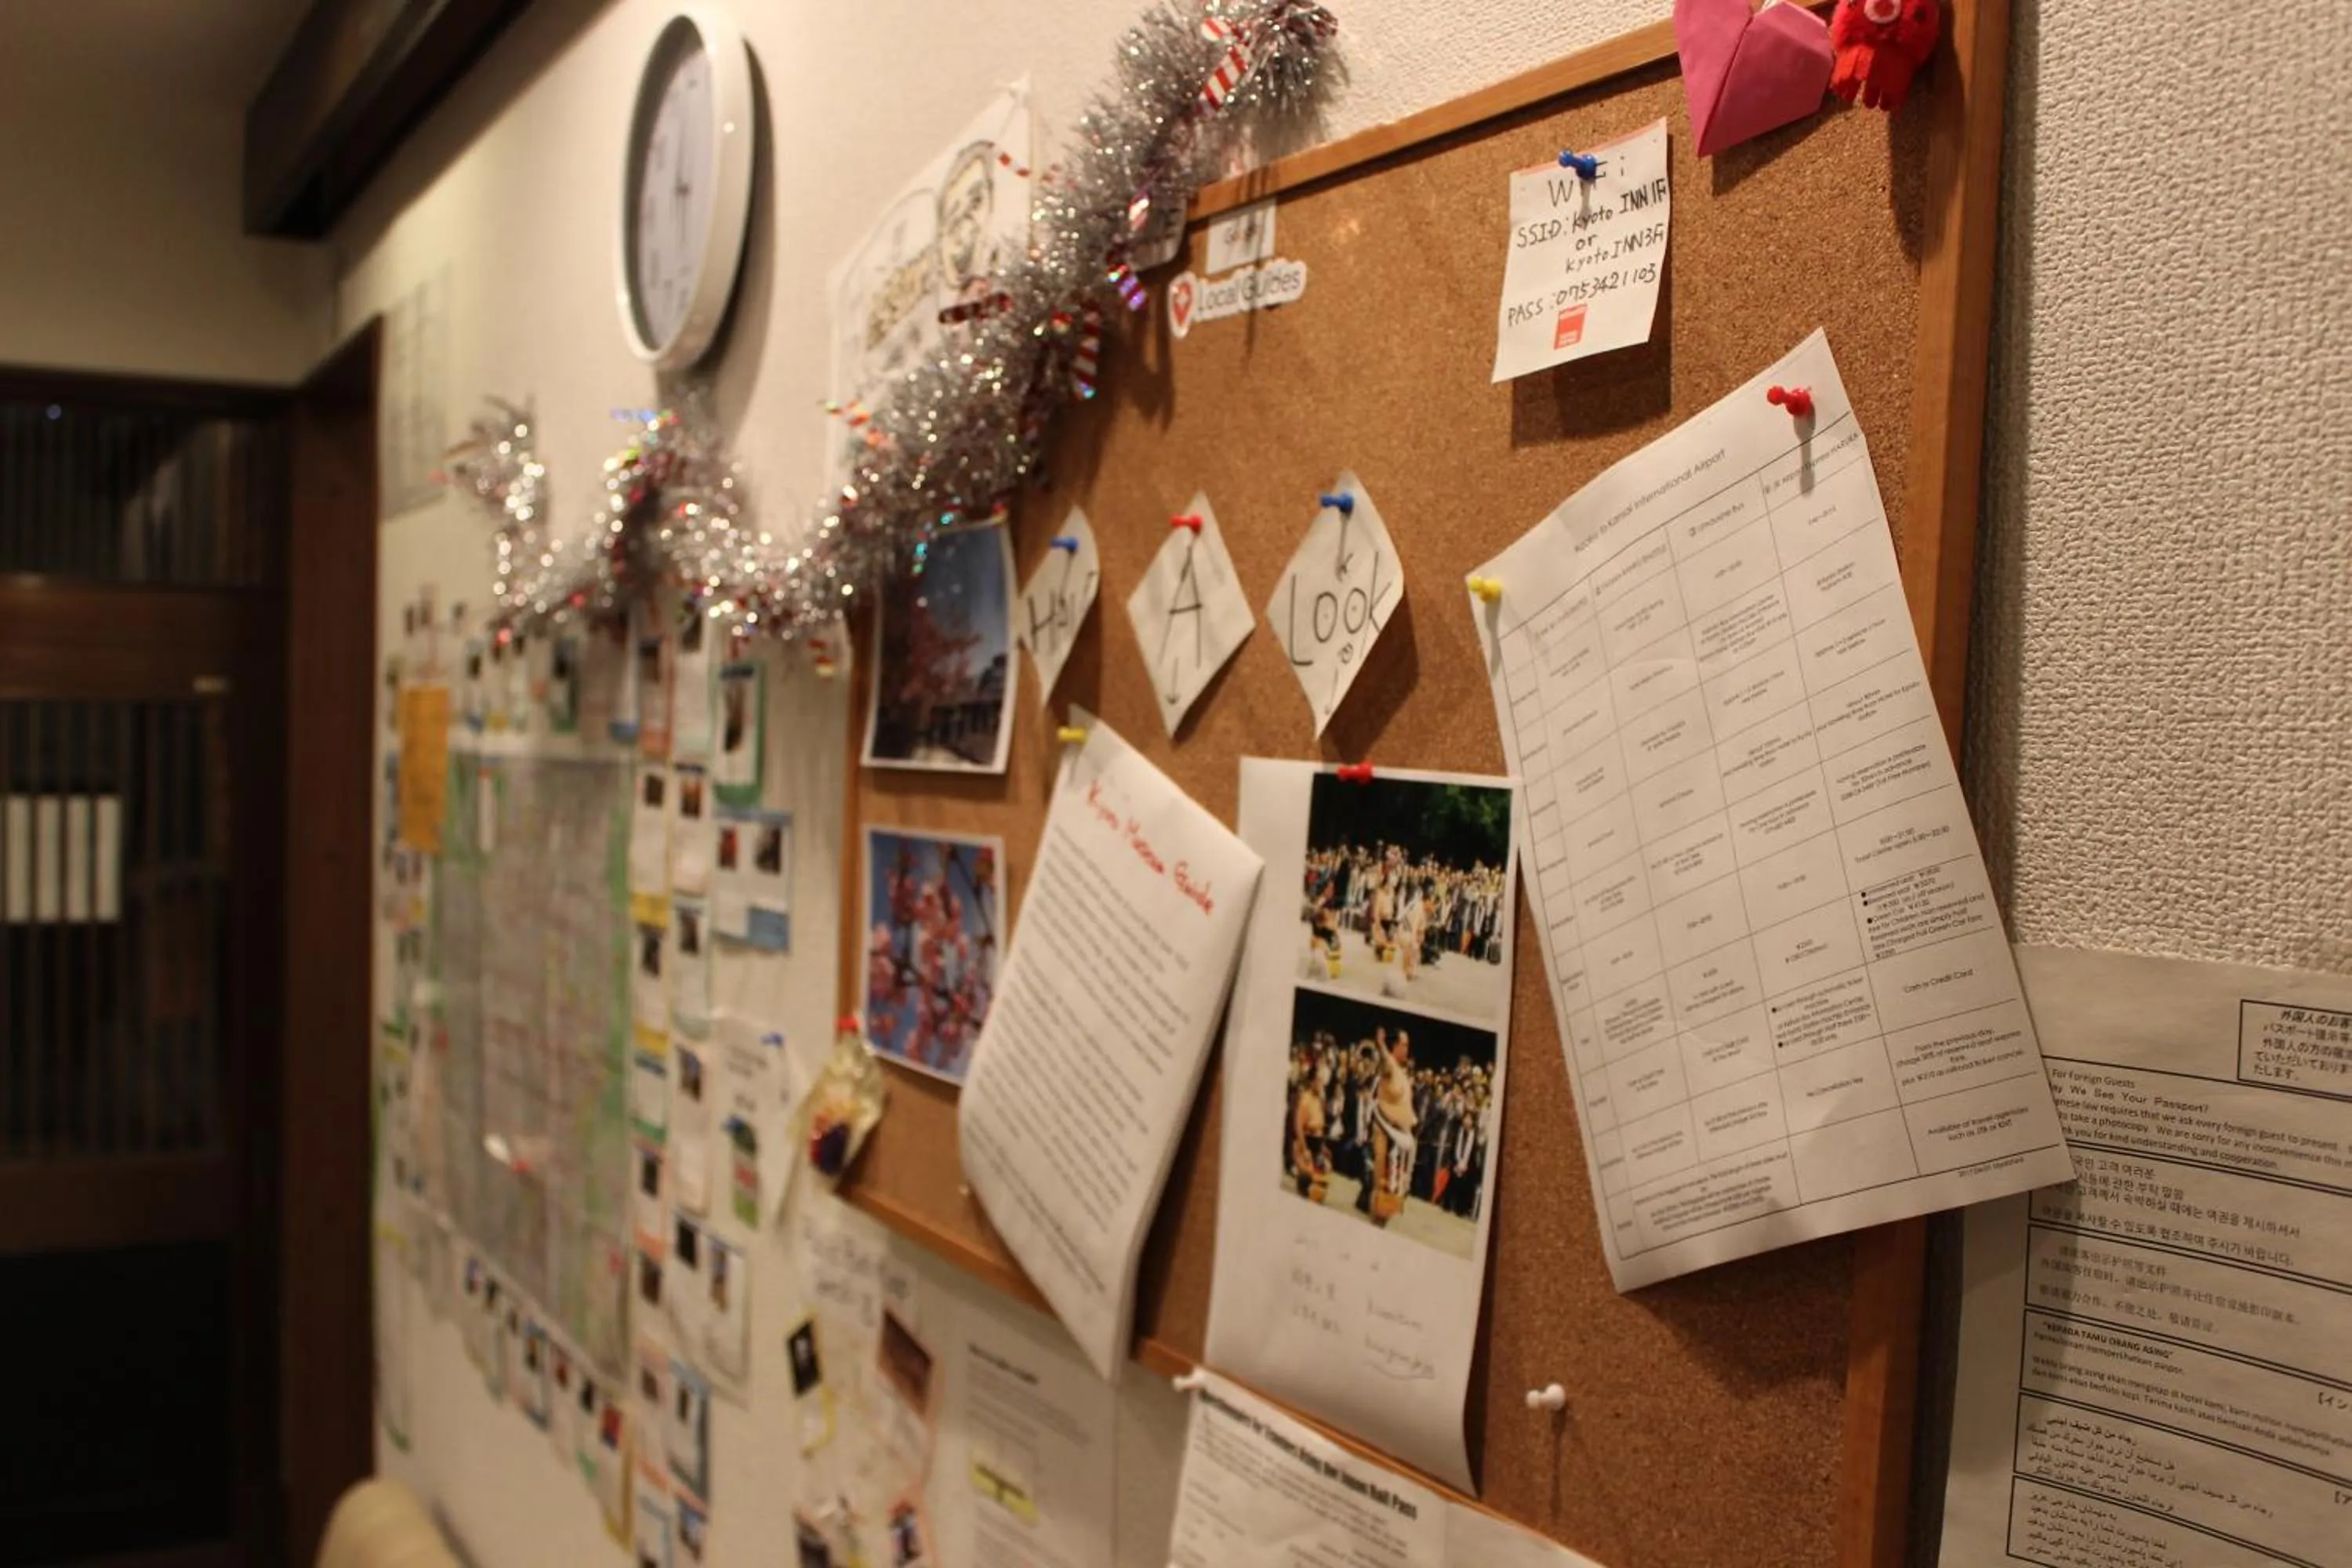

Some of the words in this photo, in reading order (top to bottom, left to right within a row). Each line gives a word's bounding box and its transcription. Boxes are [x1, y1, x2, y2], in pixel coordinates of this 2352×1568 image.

[1576, 234, 1599, 251] or
[1633, 470, 1692, 509] International
[1693, 448, 1726, 474] Airport
[1159, 541, 1203, 669] A
[1289, 551, 1392, 666] LOOK
[2051, 1068, 2067, 1079] For
[2103, 1076, 2136, 1089] Guests
[2069, 1084, 2087, 1095] We
[2093, 1087, 2114, 1100] See
[2121, 1091, 2147, 1104] Your
[2153, 1096, 2209, 1113] Passport?
[2070, 1112, 2090, 1123] take
[2191, 1132, 2215, 1145] sorry
[2100, 1105, 2139, 1117] requires
[2140, 1109, 2160, 1120] that
[2195, 1119, 2222, 1133] every
[2130, 1137, 2198, 1156] understanding
[2081, 1330, 2107, 1344] TAMU
[2108, 1337, 2140, 1352] ORANG
[2143, 1394, 2172, 1410] Terima
